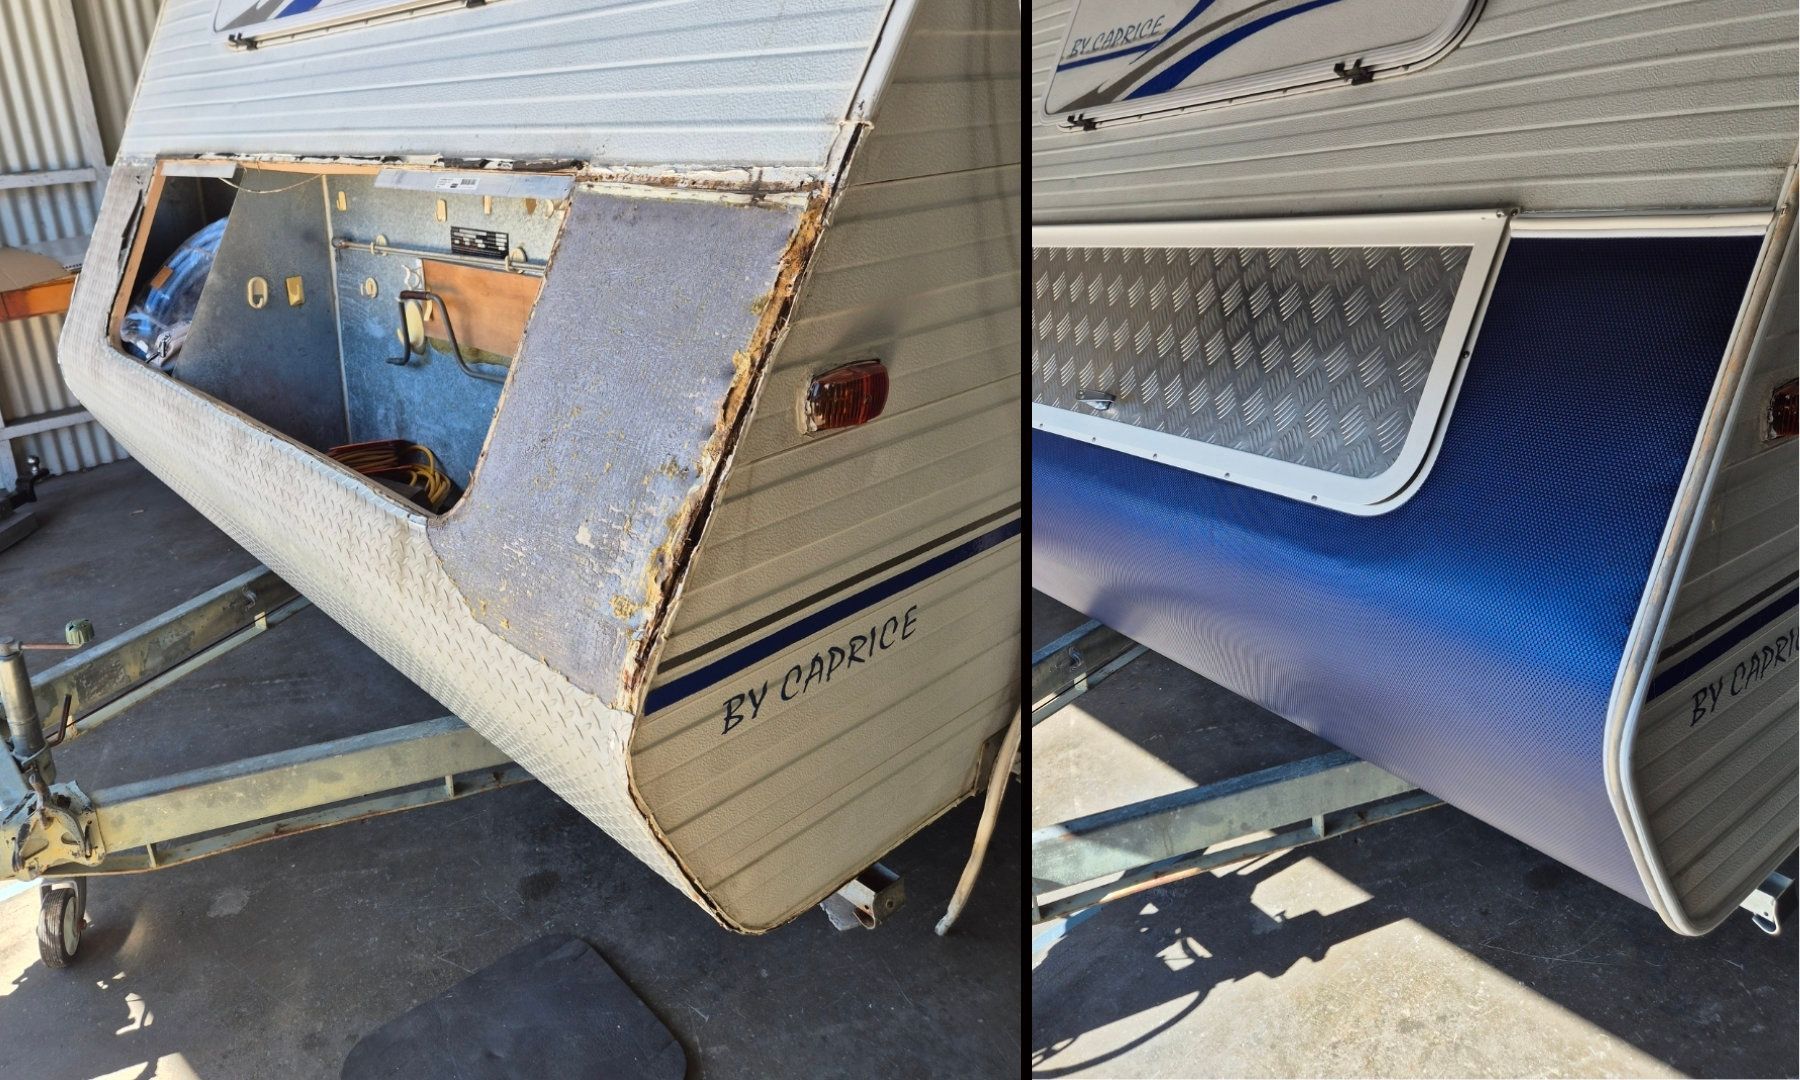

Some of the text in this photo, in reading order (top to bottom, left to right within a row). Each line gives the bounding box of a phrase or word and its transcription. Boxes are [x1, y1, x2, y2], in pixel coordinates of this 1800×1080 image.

[1070, 14, 1165, 57] BY CAPRICE
[721, 604, 917, 735] BY CAPRICE
[1689, 624, 1799, 727] BY CAPRI
